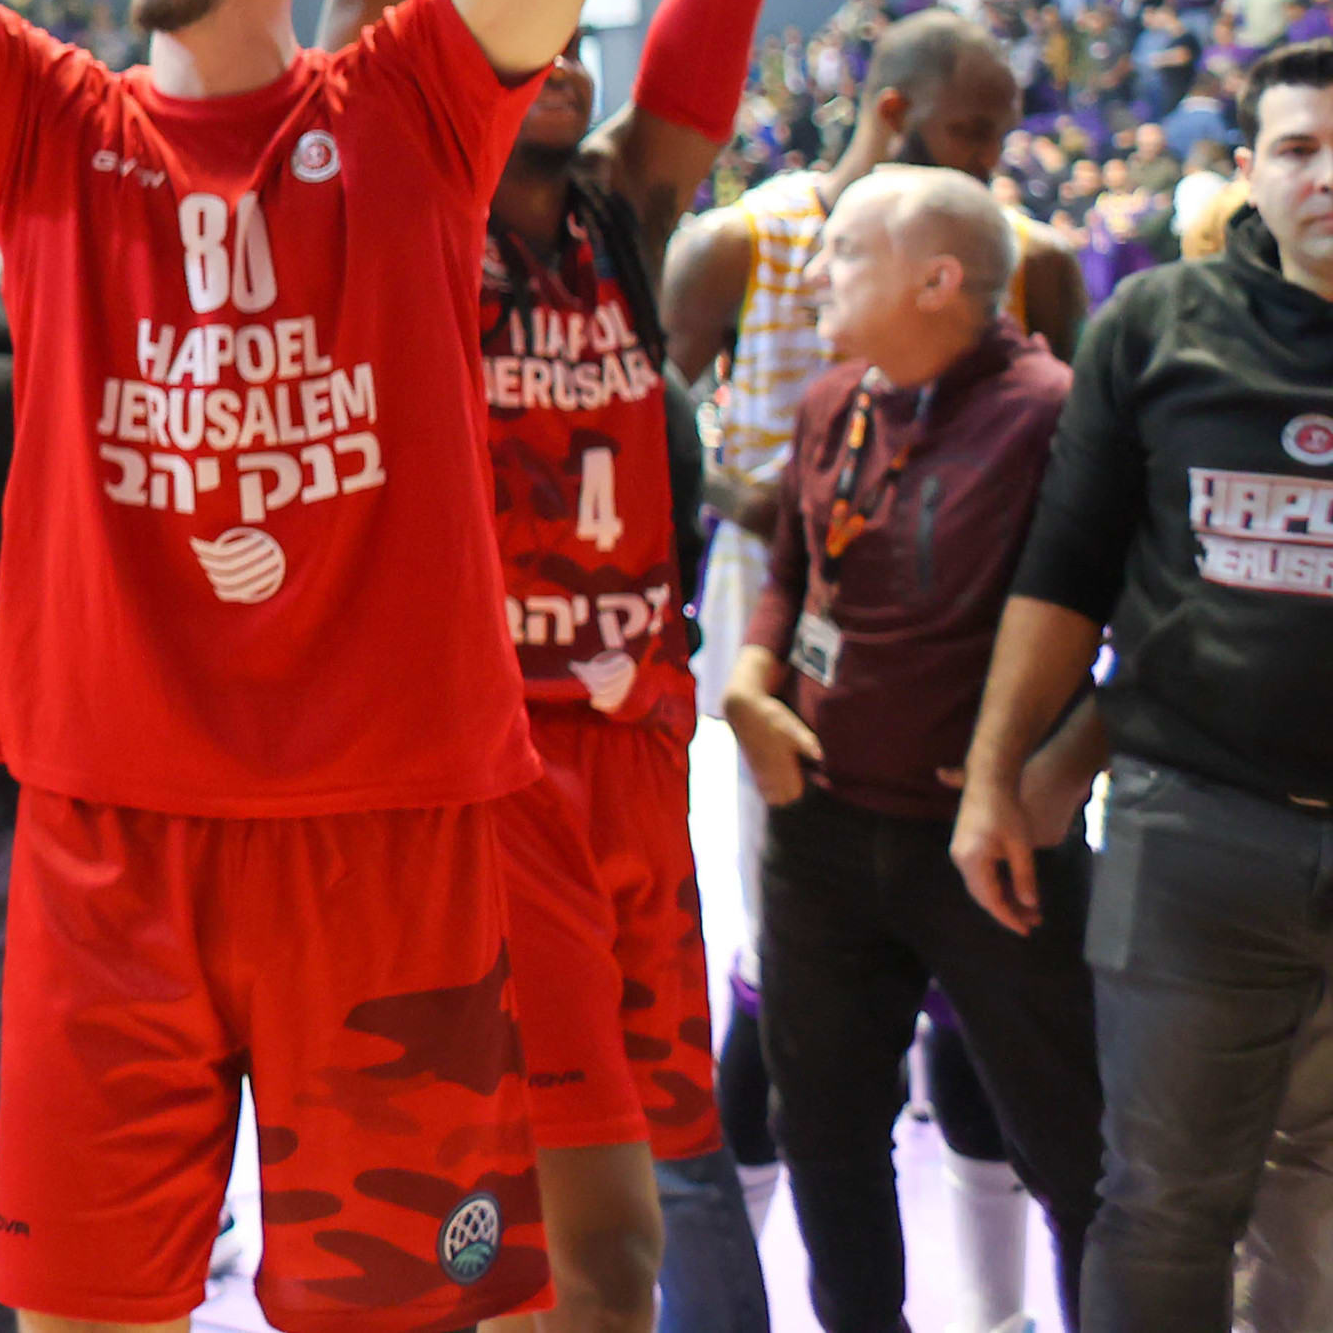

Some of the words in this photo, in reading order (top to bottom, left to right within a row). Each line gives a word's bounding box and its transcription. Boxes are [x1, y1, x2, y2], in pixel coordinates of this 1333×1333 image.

[178, 190, 277, 314] 80
[137, 315, 332, 385] HAPOEL
[97, 363, 377, 451] JERUSALEM
[99, 443, 220, 515] יהב
[237, 431, 386, 523] בנק
[576, 446, 623, 552] 4
